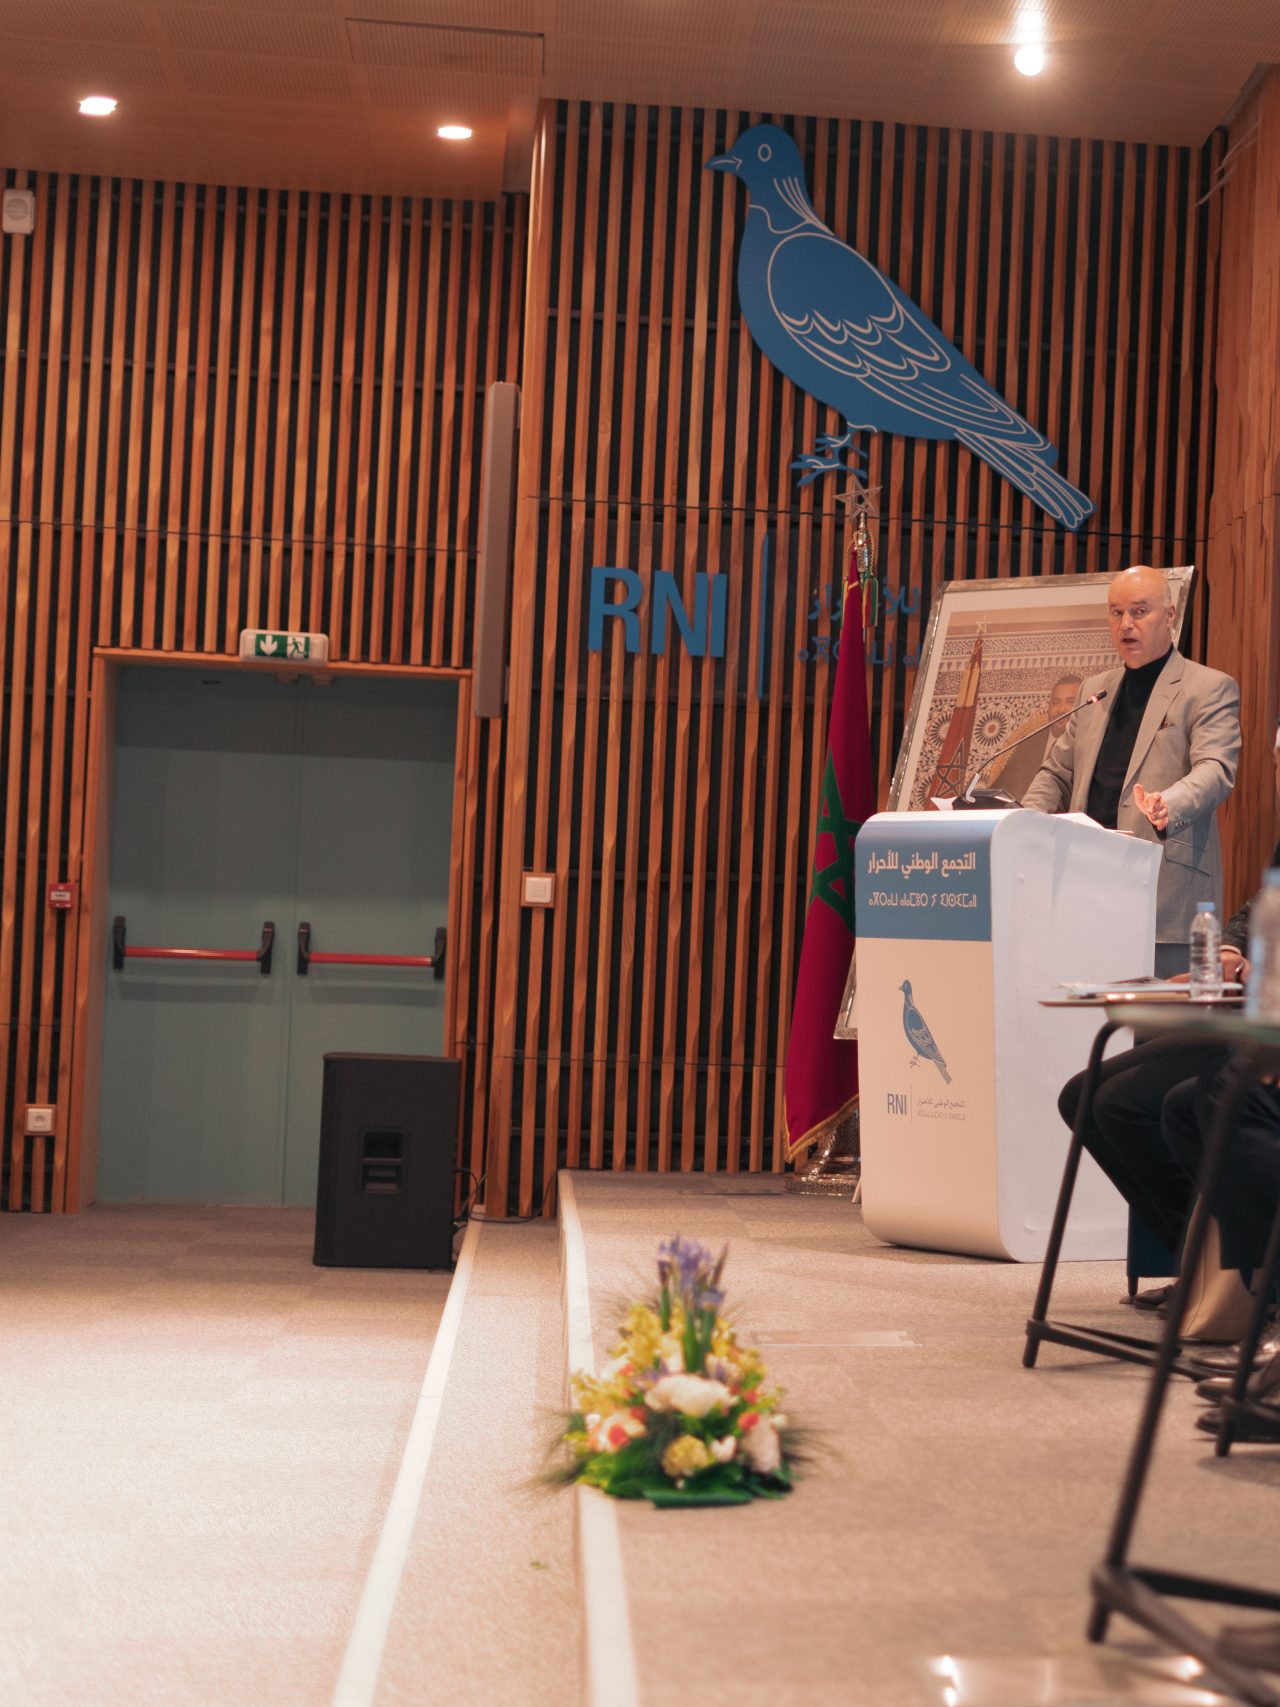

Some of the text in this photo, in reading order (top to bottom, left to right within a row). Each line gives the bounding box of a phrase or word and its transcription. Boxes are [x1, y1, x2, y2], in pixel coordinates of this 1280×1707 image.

[588, 566, 727, 658] RNI
[867, 849, 976, 879] التجمع الوطني للأحرار
[887, 1093, 907, 1115] RNI
